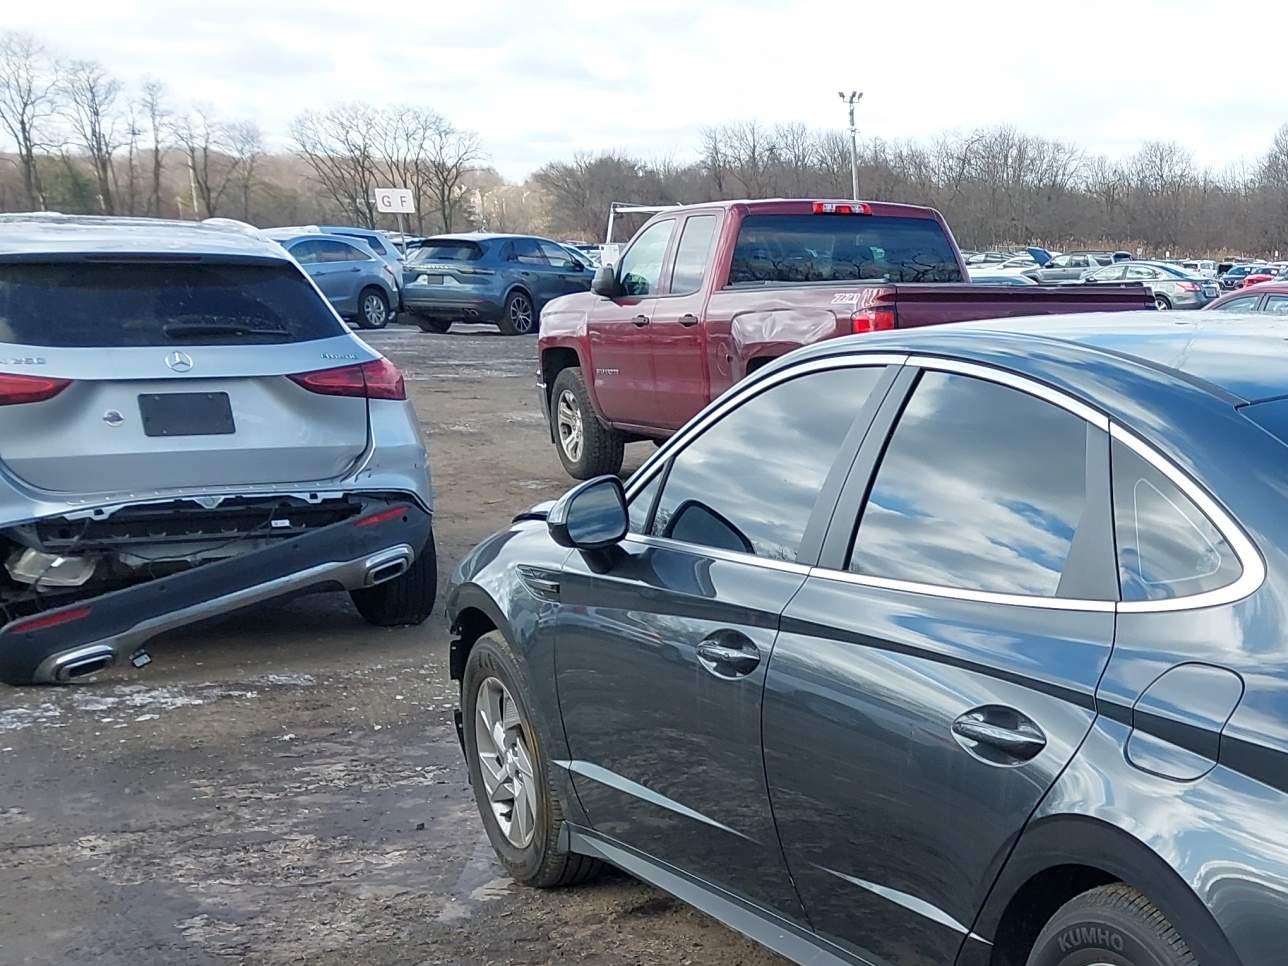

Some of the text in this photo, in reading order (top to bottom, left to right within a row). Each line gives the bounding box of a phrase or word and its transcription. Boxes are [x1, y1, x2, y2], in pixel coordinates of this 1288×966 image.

[381, 195, 408, 208] G F
[1058, 927, 1125, 953] KUMHO
